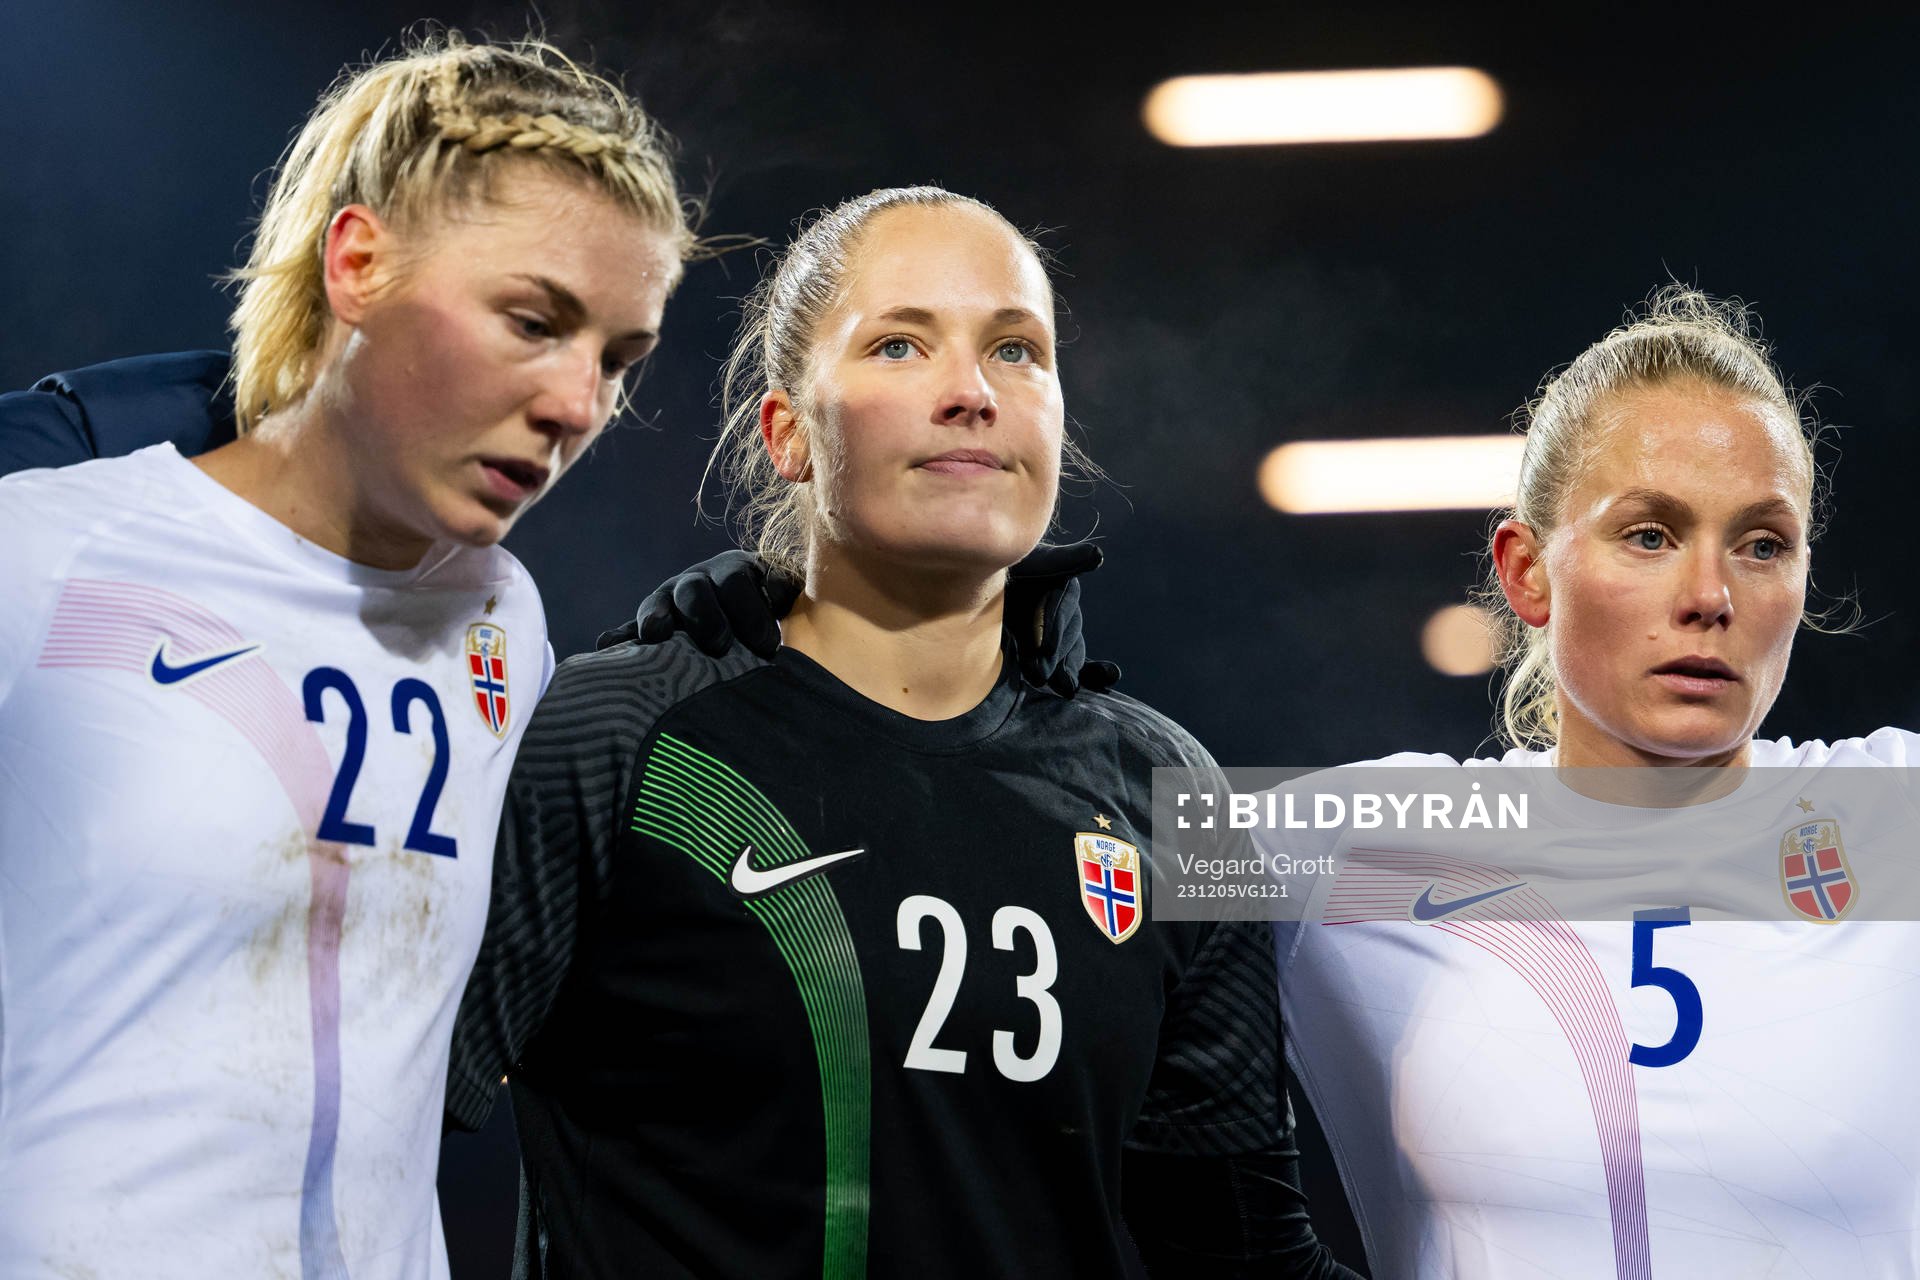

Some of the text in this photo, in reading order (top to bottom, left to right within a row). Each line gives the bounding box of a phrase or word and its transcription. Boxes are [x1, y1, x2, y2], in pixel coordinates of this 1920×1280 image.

[302, 666, 458, 859] 22
[1095, 839, 1116, 853] NORGE
[896, 895, 1063, 1082] 23
[1628, 905, 1704, 1068] 5
